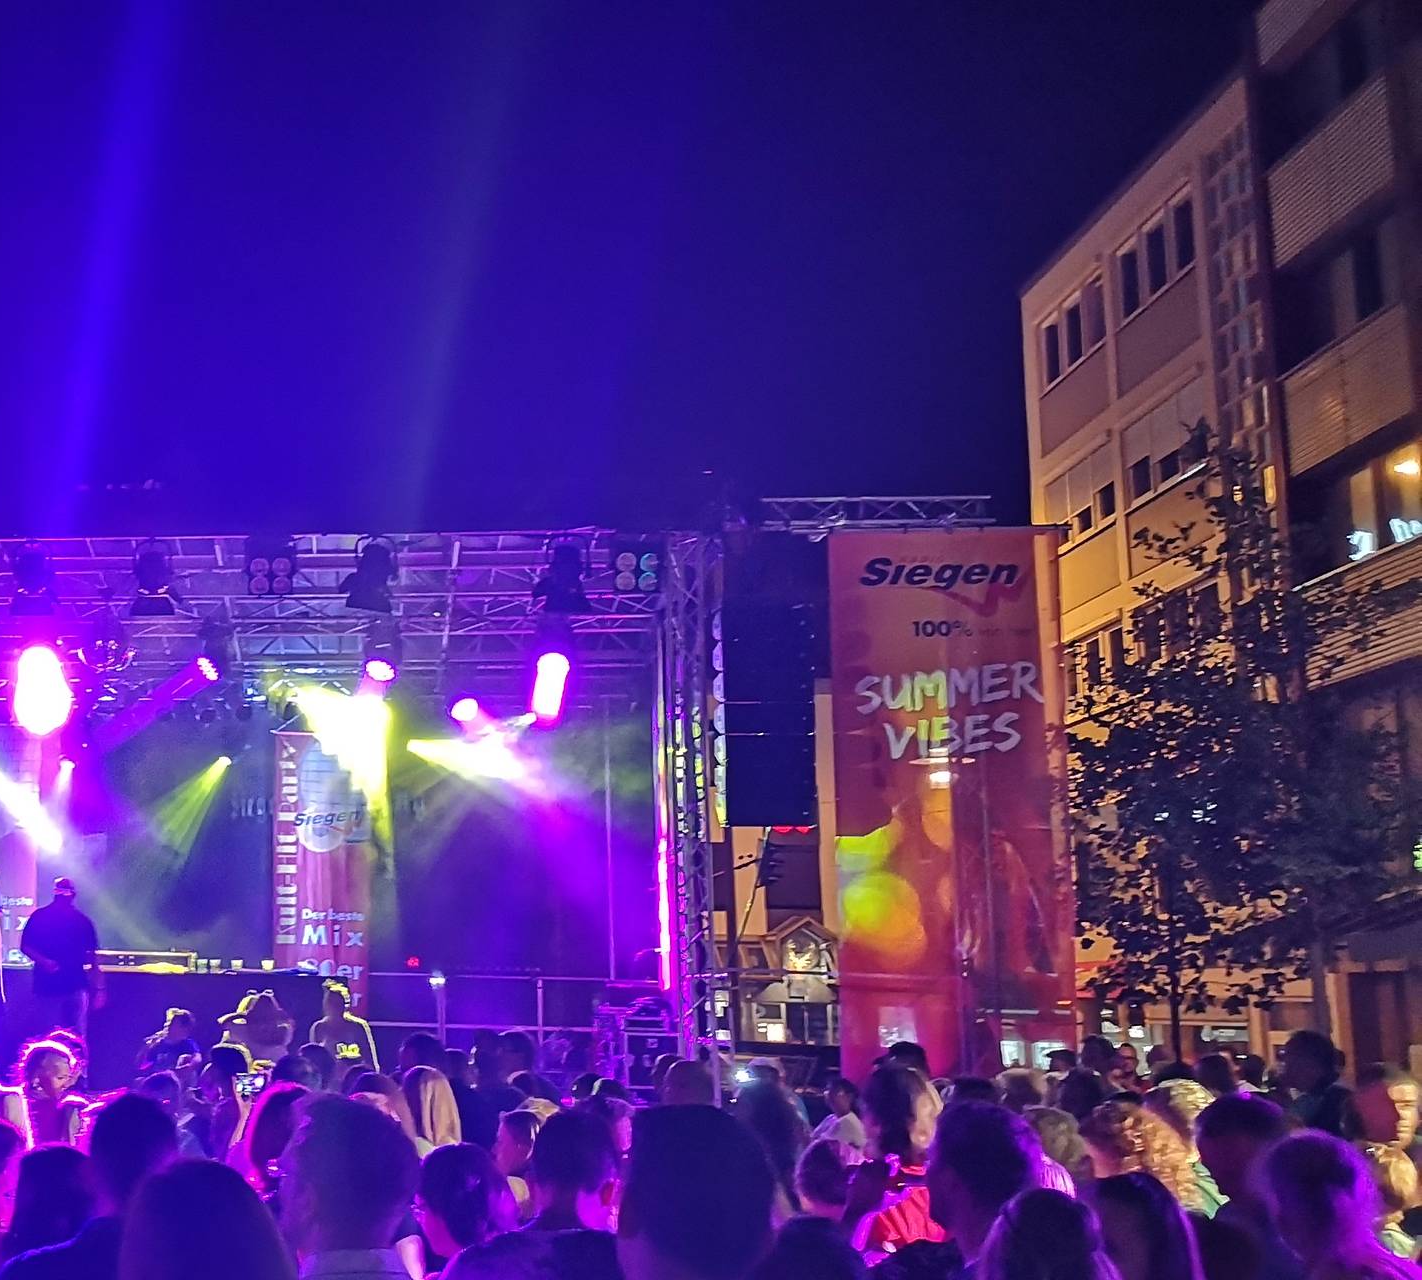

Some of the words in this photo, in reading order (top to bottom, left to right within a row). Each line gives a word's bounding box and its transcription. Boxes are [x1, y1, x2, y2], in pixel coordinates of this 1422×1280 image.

[859, 557, 1018, 590] Siegen
[854, 661, 1045, 715] SUMMER
[883, 712, 1021, 760] VIBES
[294, 811, 361, 827] Siegen
[302, 924, 363, 946] Mix
